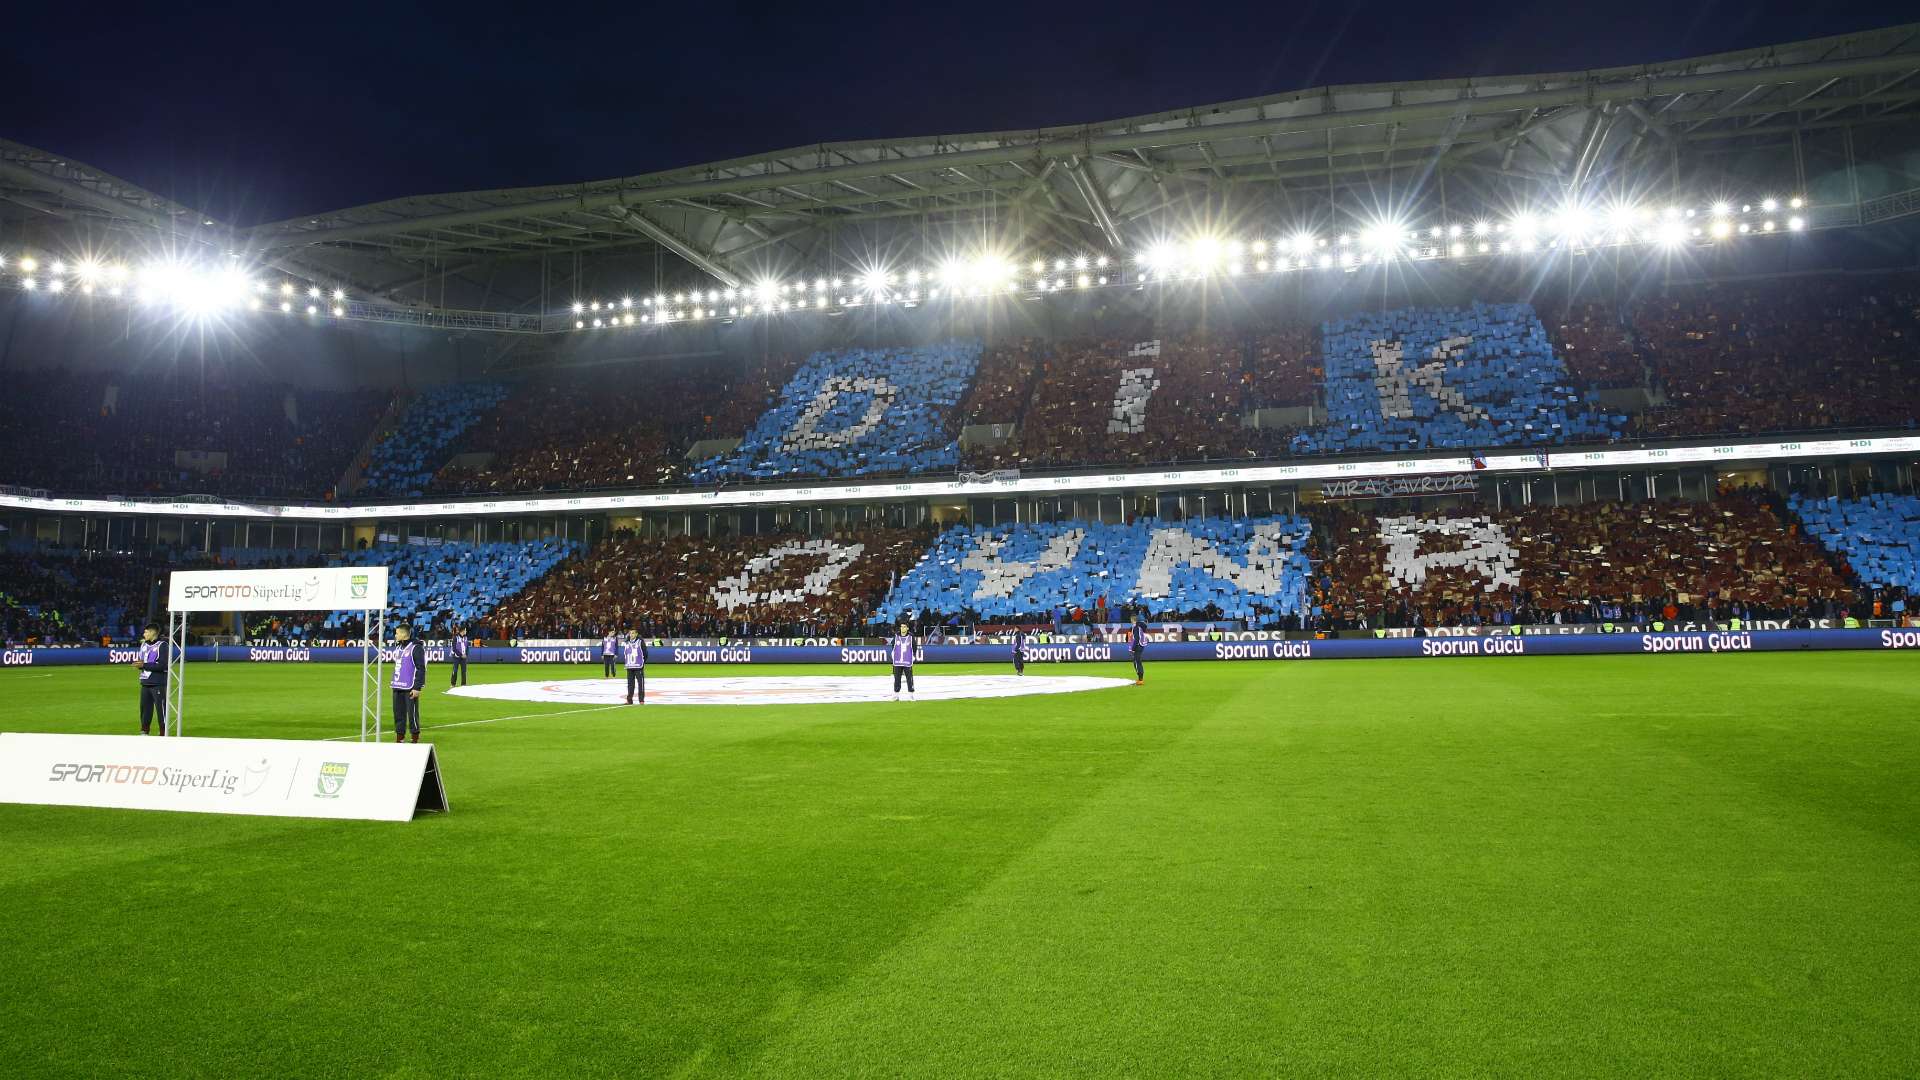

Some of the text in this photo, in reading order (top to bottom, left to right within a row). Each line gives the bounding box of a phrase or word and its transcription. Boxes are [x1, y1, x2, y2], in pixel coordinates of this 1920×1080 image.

[1326, 473, 1475, 497] VIRA AVRUPA
[1215, 640, 1310, 660] Sporun Gücü
[1423, 636, 1523, 657] Sporun Gücü
[1642, 631, 1751, 653] Sporun Gücü
[3, 649, 33, 665] Gücü
[109, 650, 139, 664] Sporu
[250, 647, 310, 662] Sporun Gücü
[520, 647, 591, 664] Sporun Gücü
[674, 646, 751, 664] Sporun Gücü
[841, 647, 888, 663] Sporun
[1022, 643, 1111, 662] Sporun Gücü
[49, 763, 239, 794] SPORTOTO SüperLig
